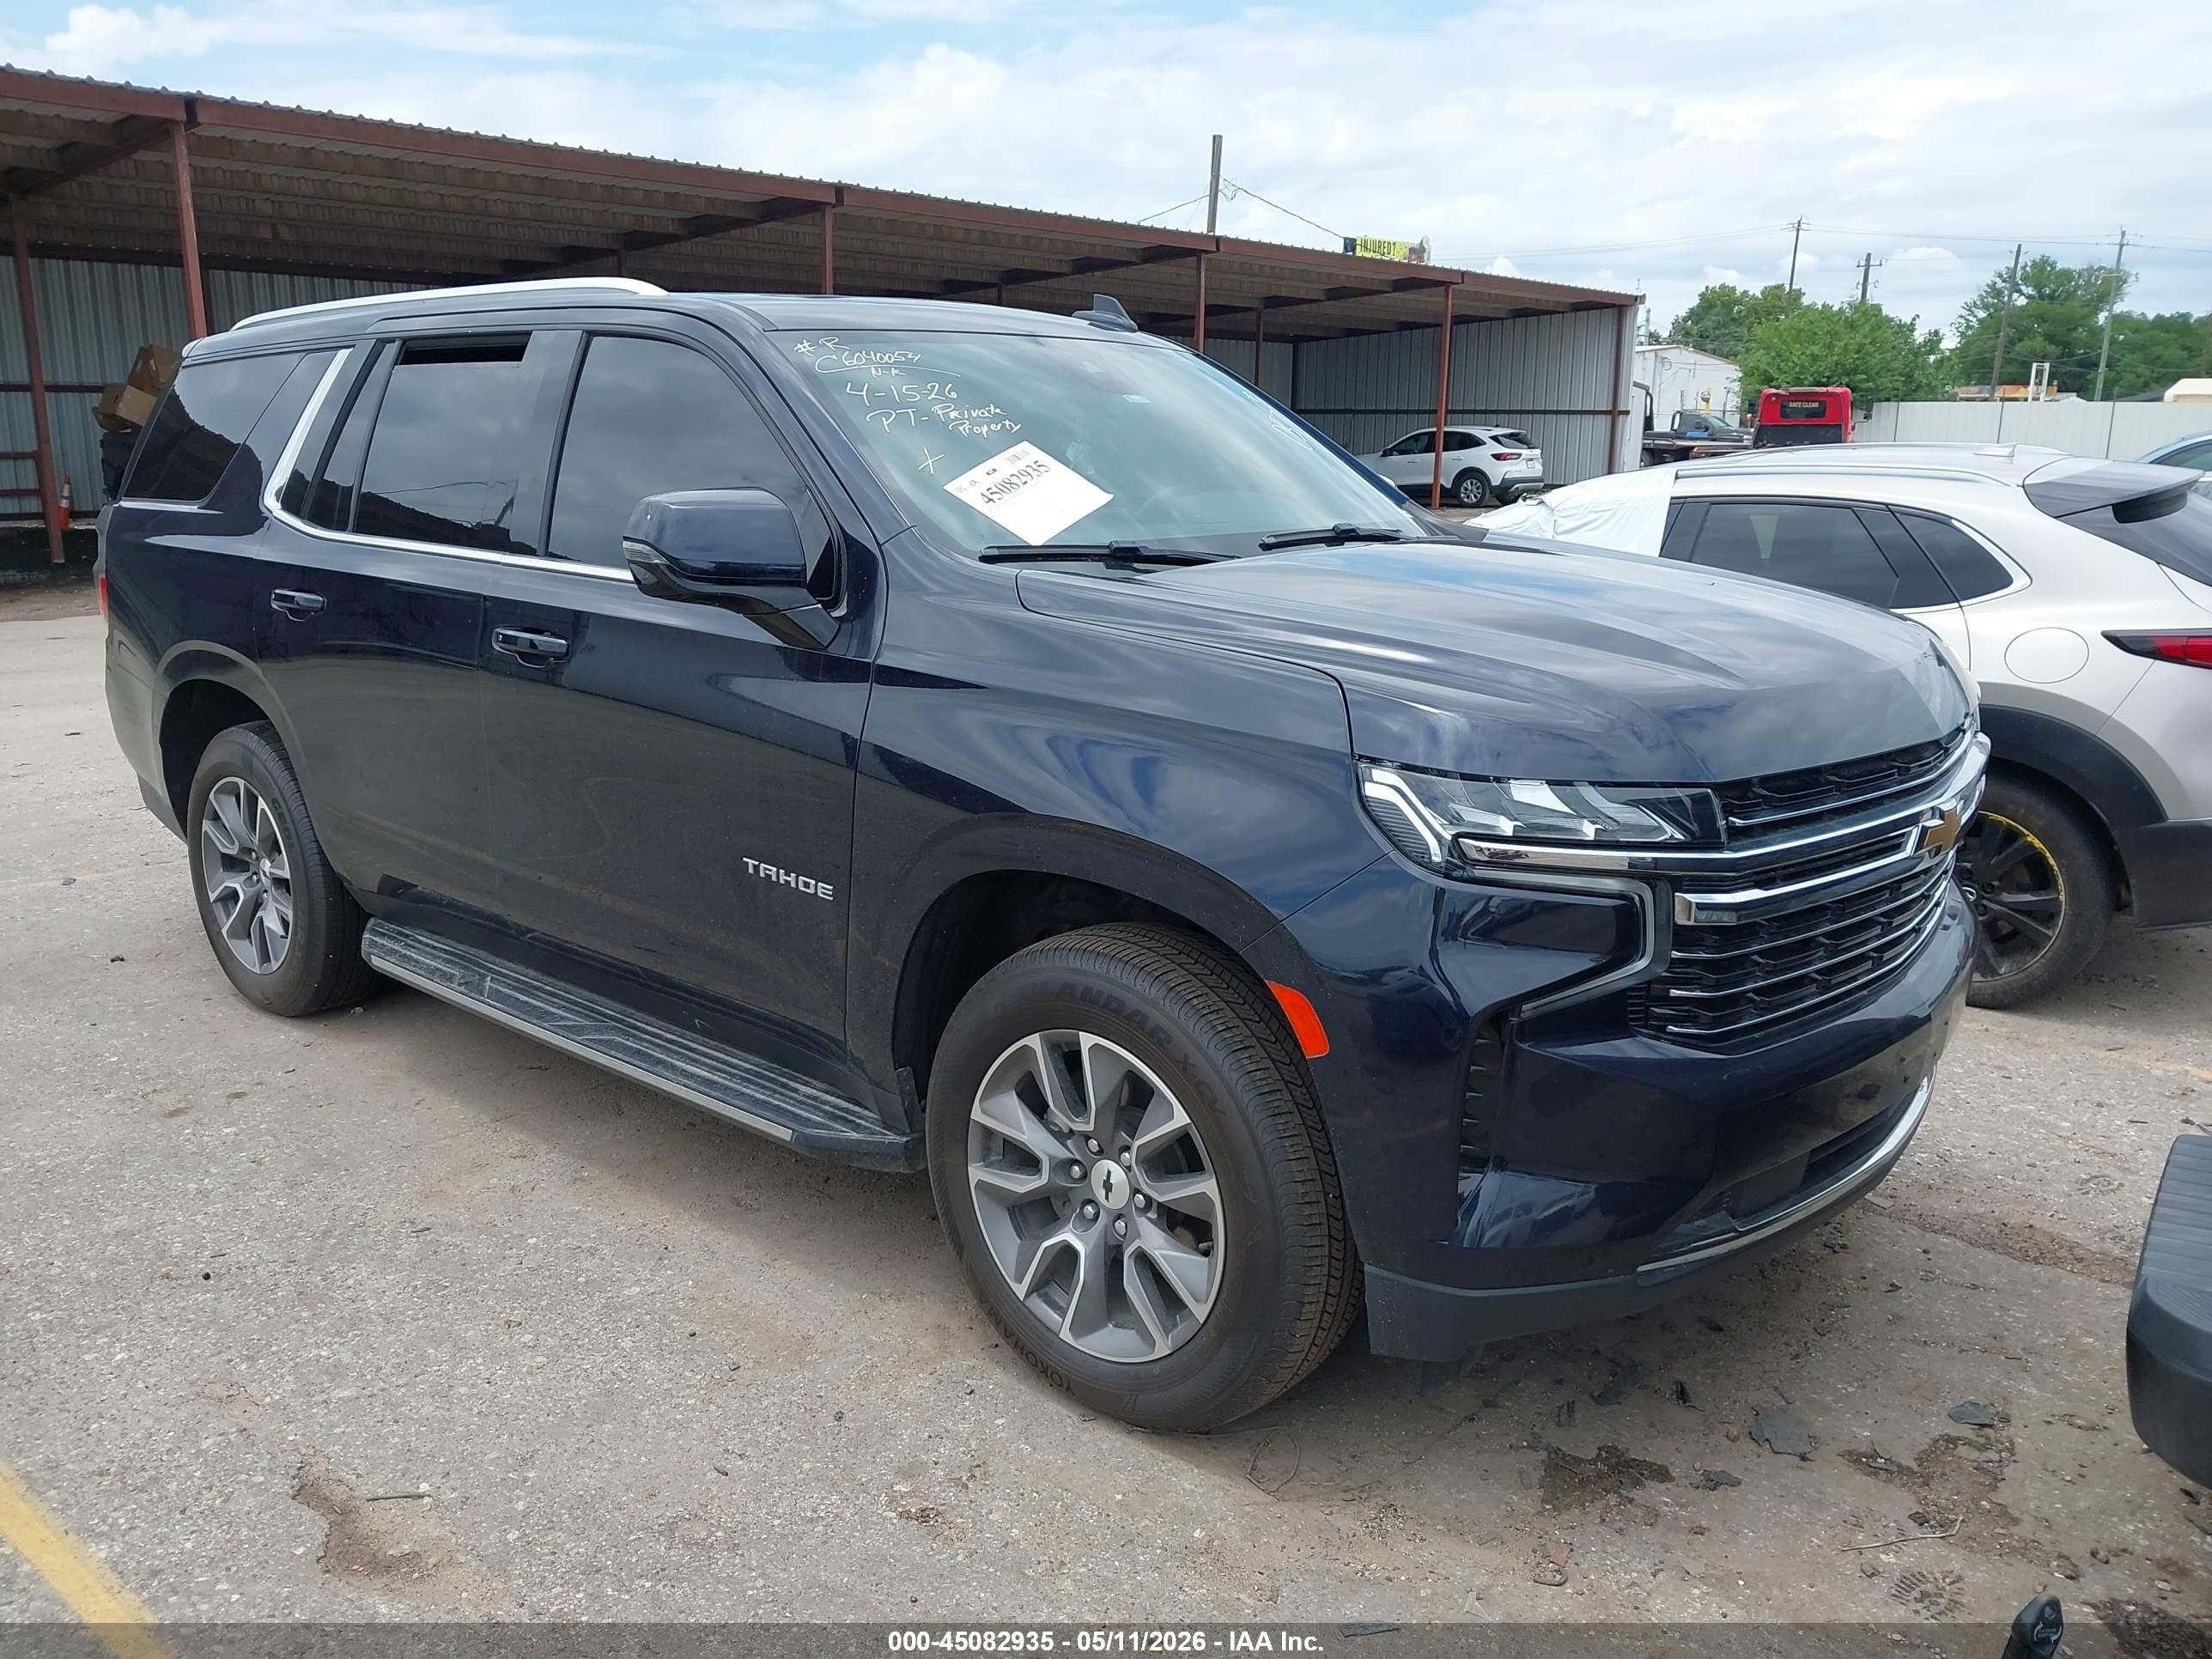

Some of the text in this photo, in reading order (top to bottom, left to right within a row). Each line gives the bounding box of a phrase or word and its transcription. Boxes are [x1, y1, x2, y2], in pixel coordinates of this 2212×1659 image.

[1359, 238, 1397, 257] INJURED?
[948, 419, 1022, 439] Property
[980, 459, 1052, 505] 45082935
[743, 857, 834, 901] TAHOE
